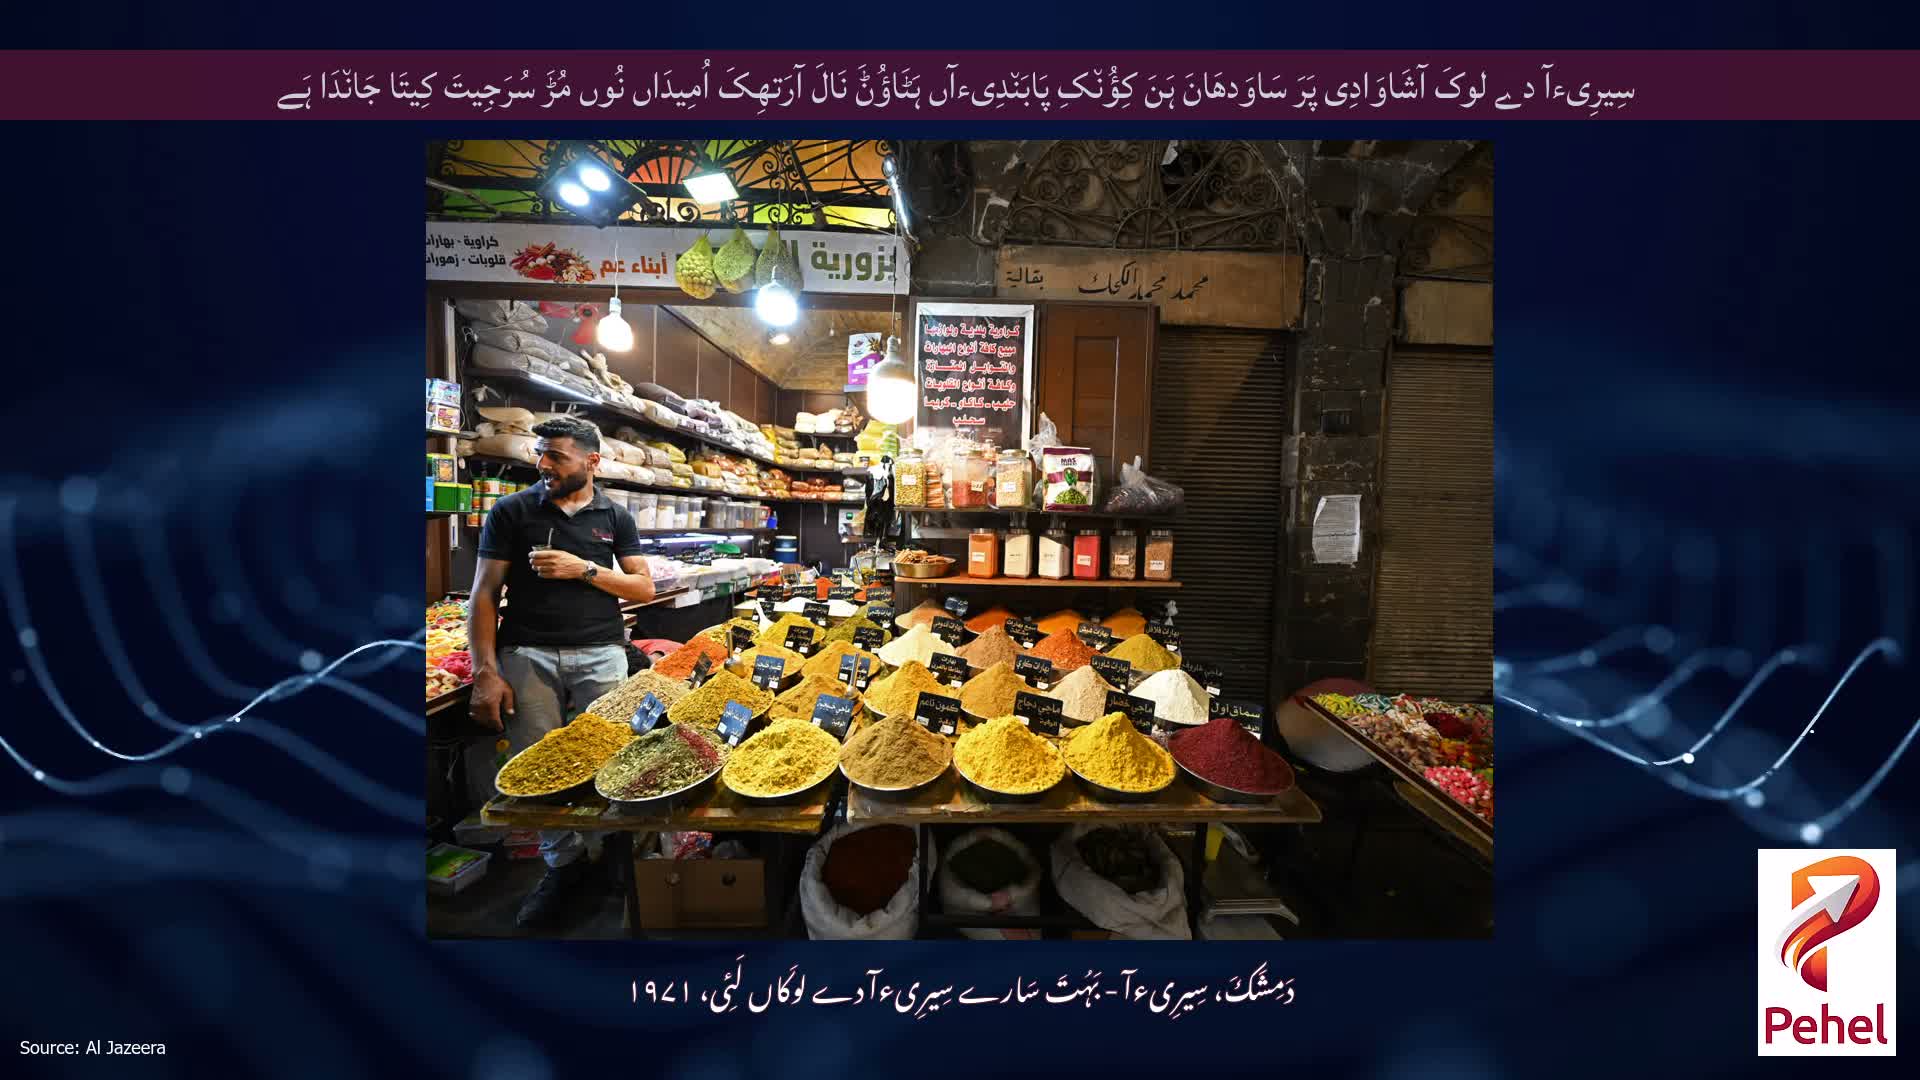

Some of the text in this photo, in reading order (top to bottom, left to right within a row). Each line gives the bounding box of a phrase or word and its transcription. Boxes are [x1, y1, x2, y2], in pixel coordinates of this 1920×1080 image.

[464, 235, 499, 249] كراوية
[468, 254, 506, 268] قلوبات
[600, 258, 625, 278] عم
[632, 252, 668, 280] أبناء
[1005, 267, 1044, 290] بقالية
[1169, 275, 1209, 300] محمد
[979, 341, 997, 354] كافة
[958, 397, 985, 411] كاكاو
[1229, 706, 1261, 718] سماق
